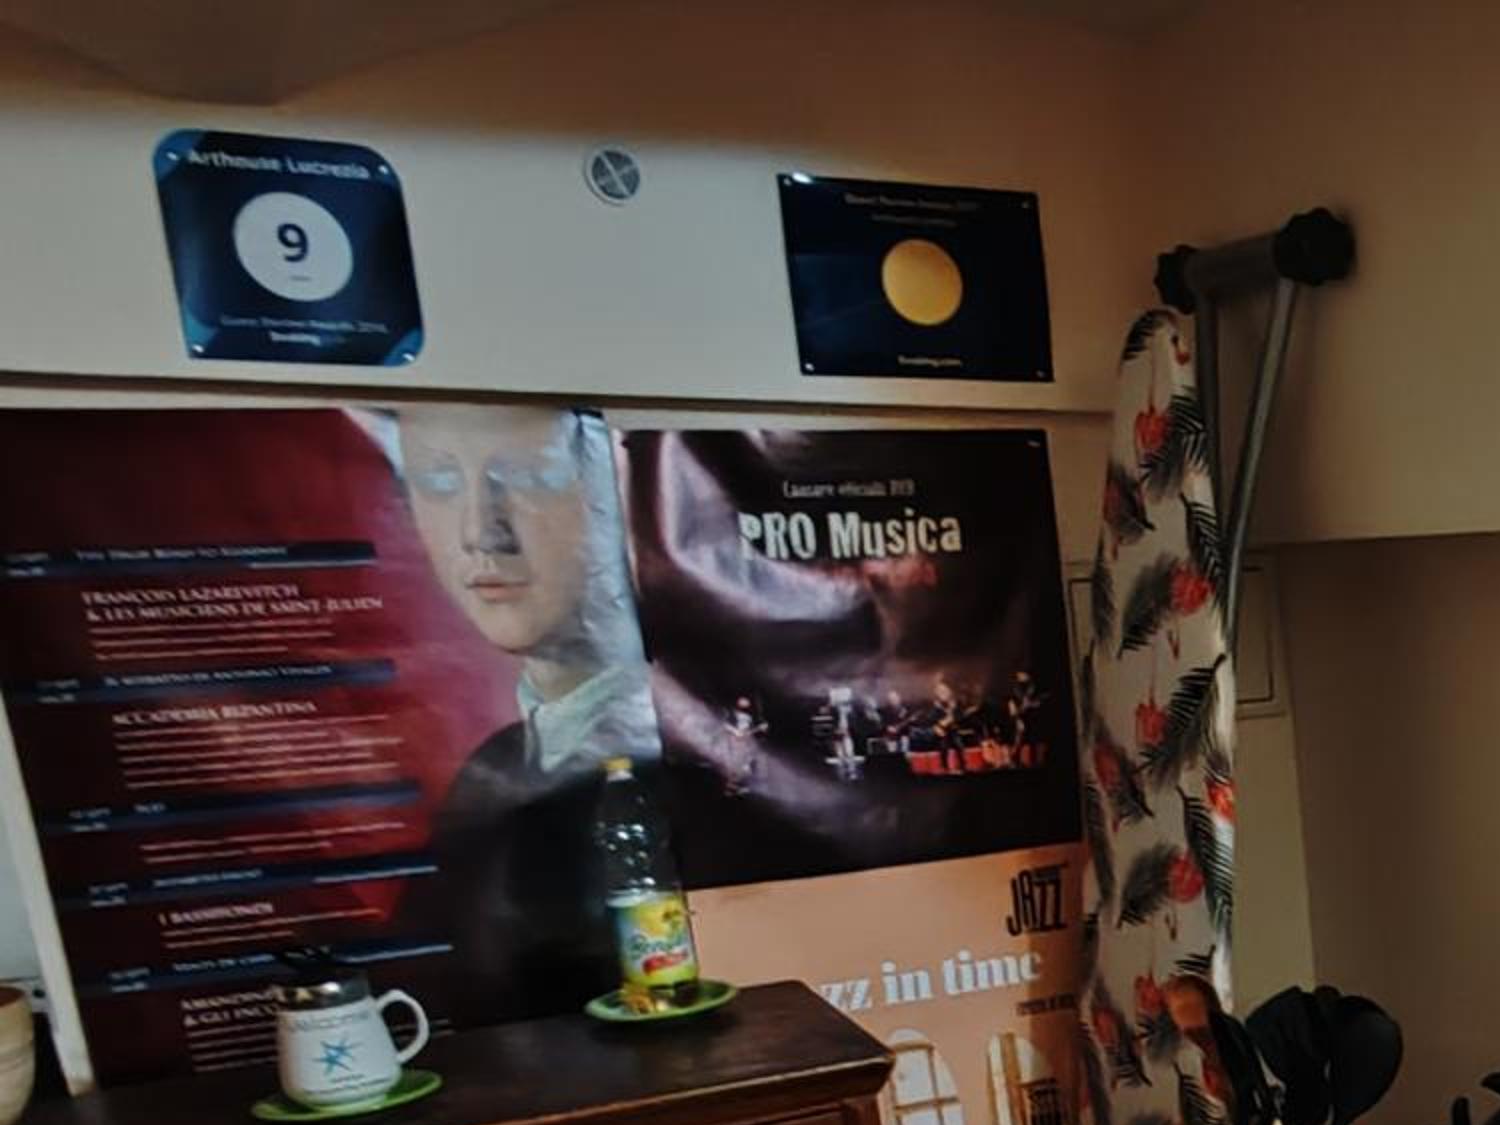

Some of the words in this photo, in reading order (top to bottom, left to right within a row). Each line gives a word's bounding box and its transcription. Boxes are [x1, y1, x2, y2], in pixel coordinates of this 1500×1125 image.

[276, 222, 309, 263] 9
[738, 511, 817, 560] PRO
[827, 507, 962, 559] Musica
[1006, 863, 1066, 936] JAZZ
[818, 979, 873, 1010] zz
[881, 960, 932, 1005] in
[943, 950, 1041, 995] time
